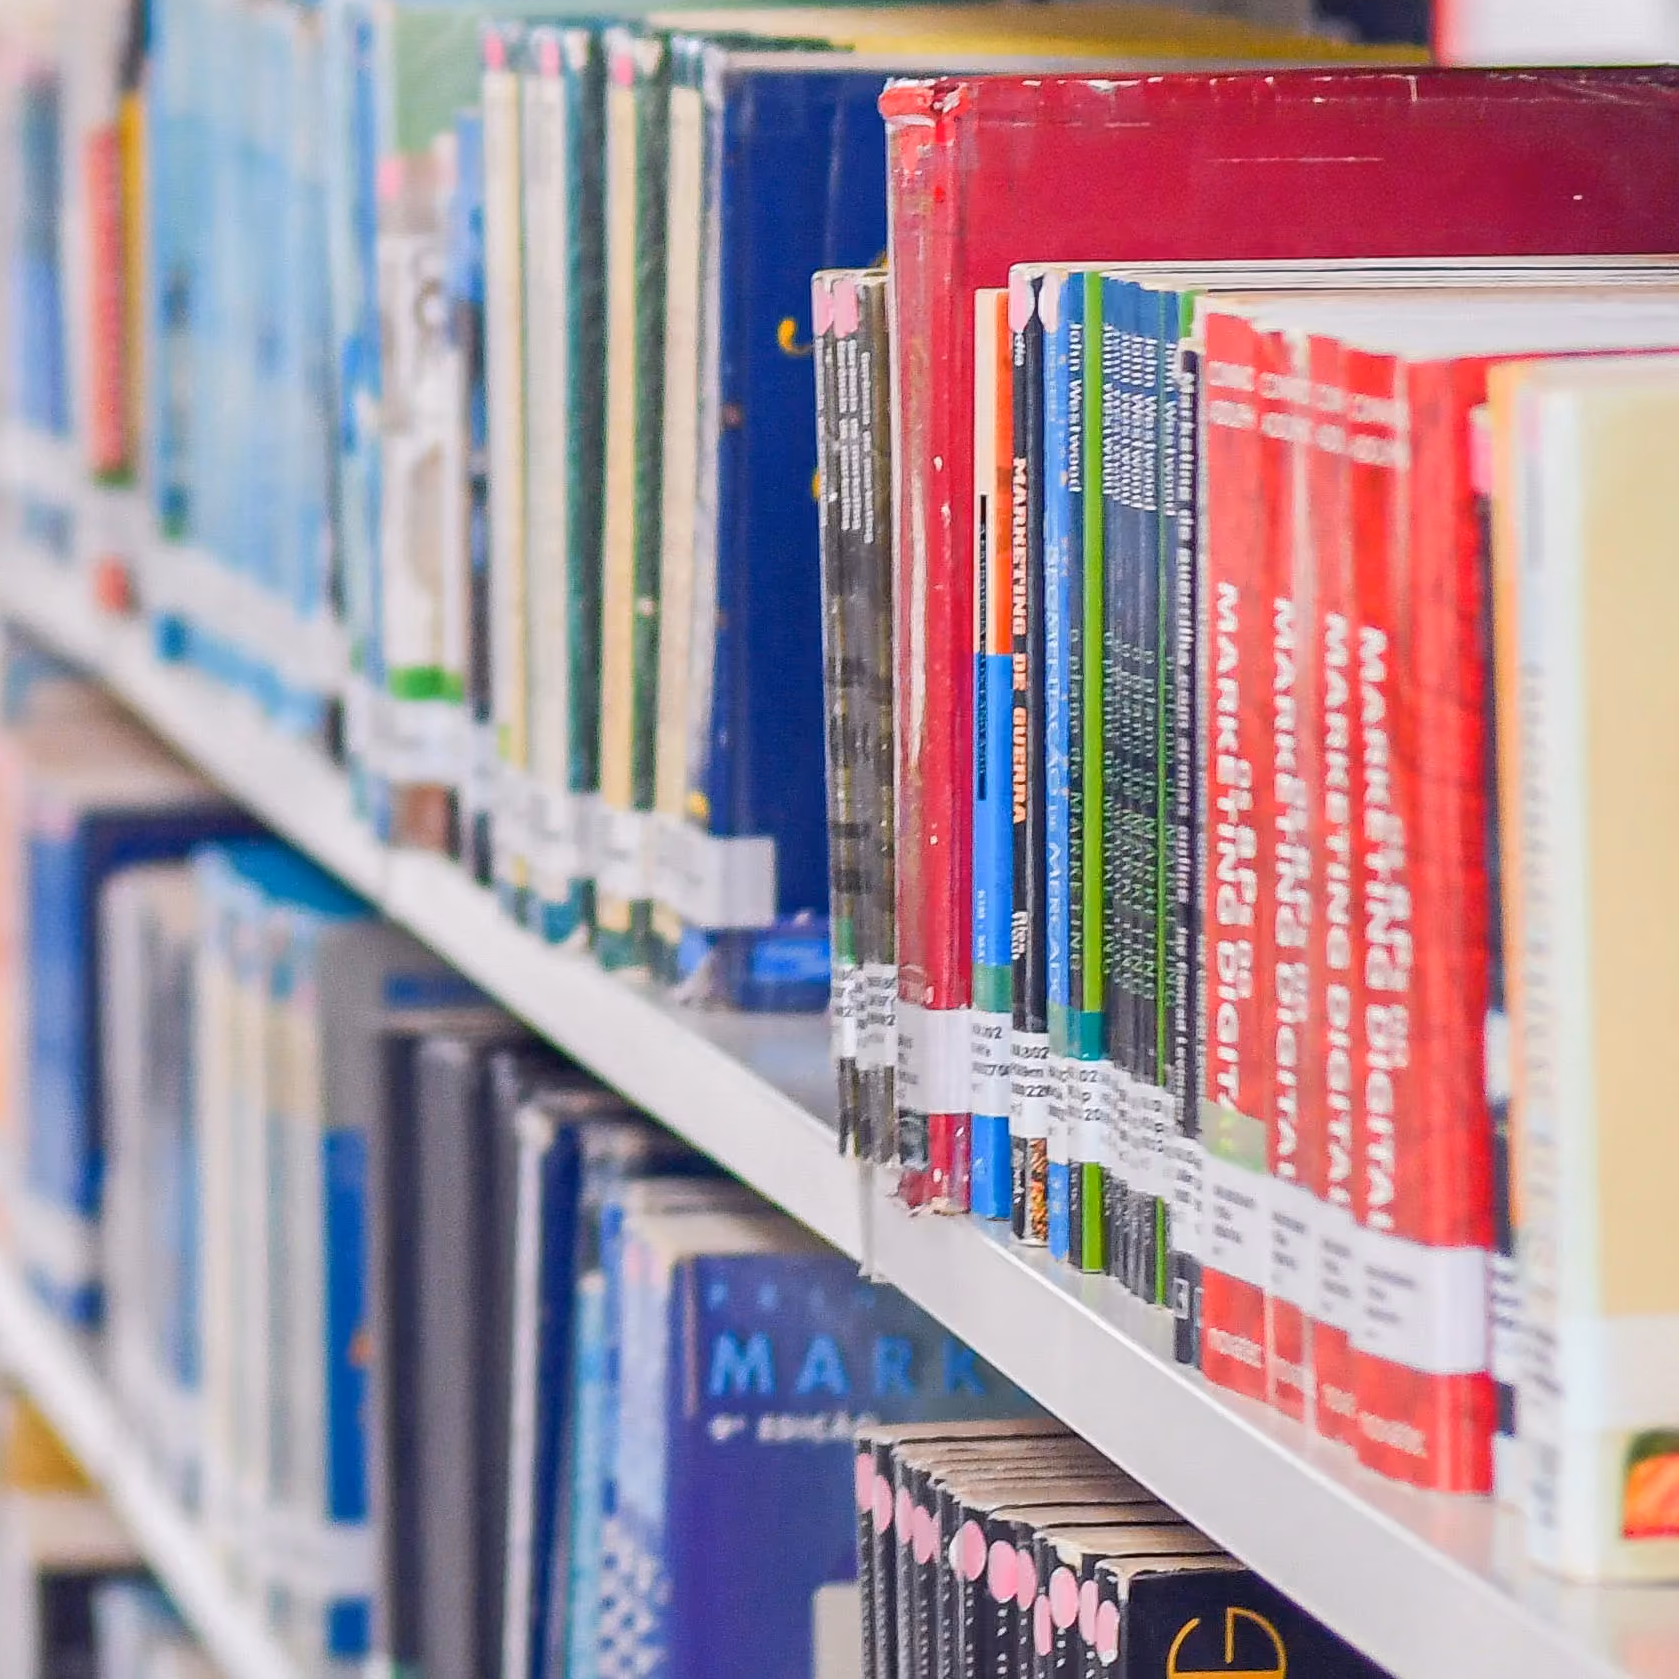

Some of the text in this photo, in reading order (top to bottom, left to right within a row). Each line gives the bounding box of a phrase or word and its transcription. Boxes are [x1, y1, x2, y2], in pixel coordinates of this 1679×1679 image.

[1067, 322, 1085, 494] John Westwood
[1012, 456, 1028, 825] MARKETING DE GUERRA
[1067, 654, 1084, 735] plano
[1068, 746, 1084, 779] de
[1325, 612, 1351, 970] MARKETING
[1069, 791, 1084, 973] MARKETING
[707, 1330, 988, 1398] MARK
